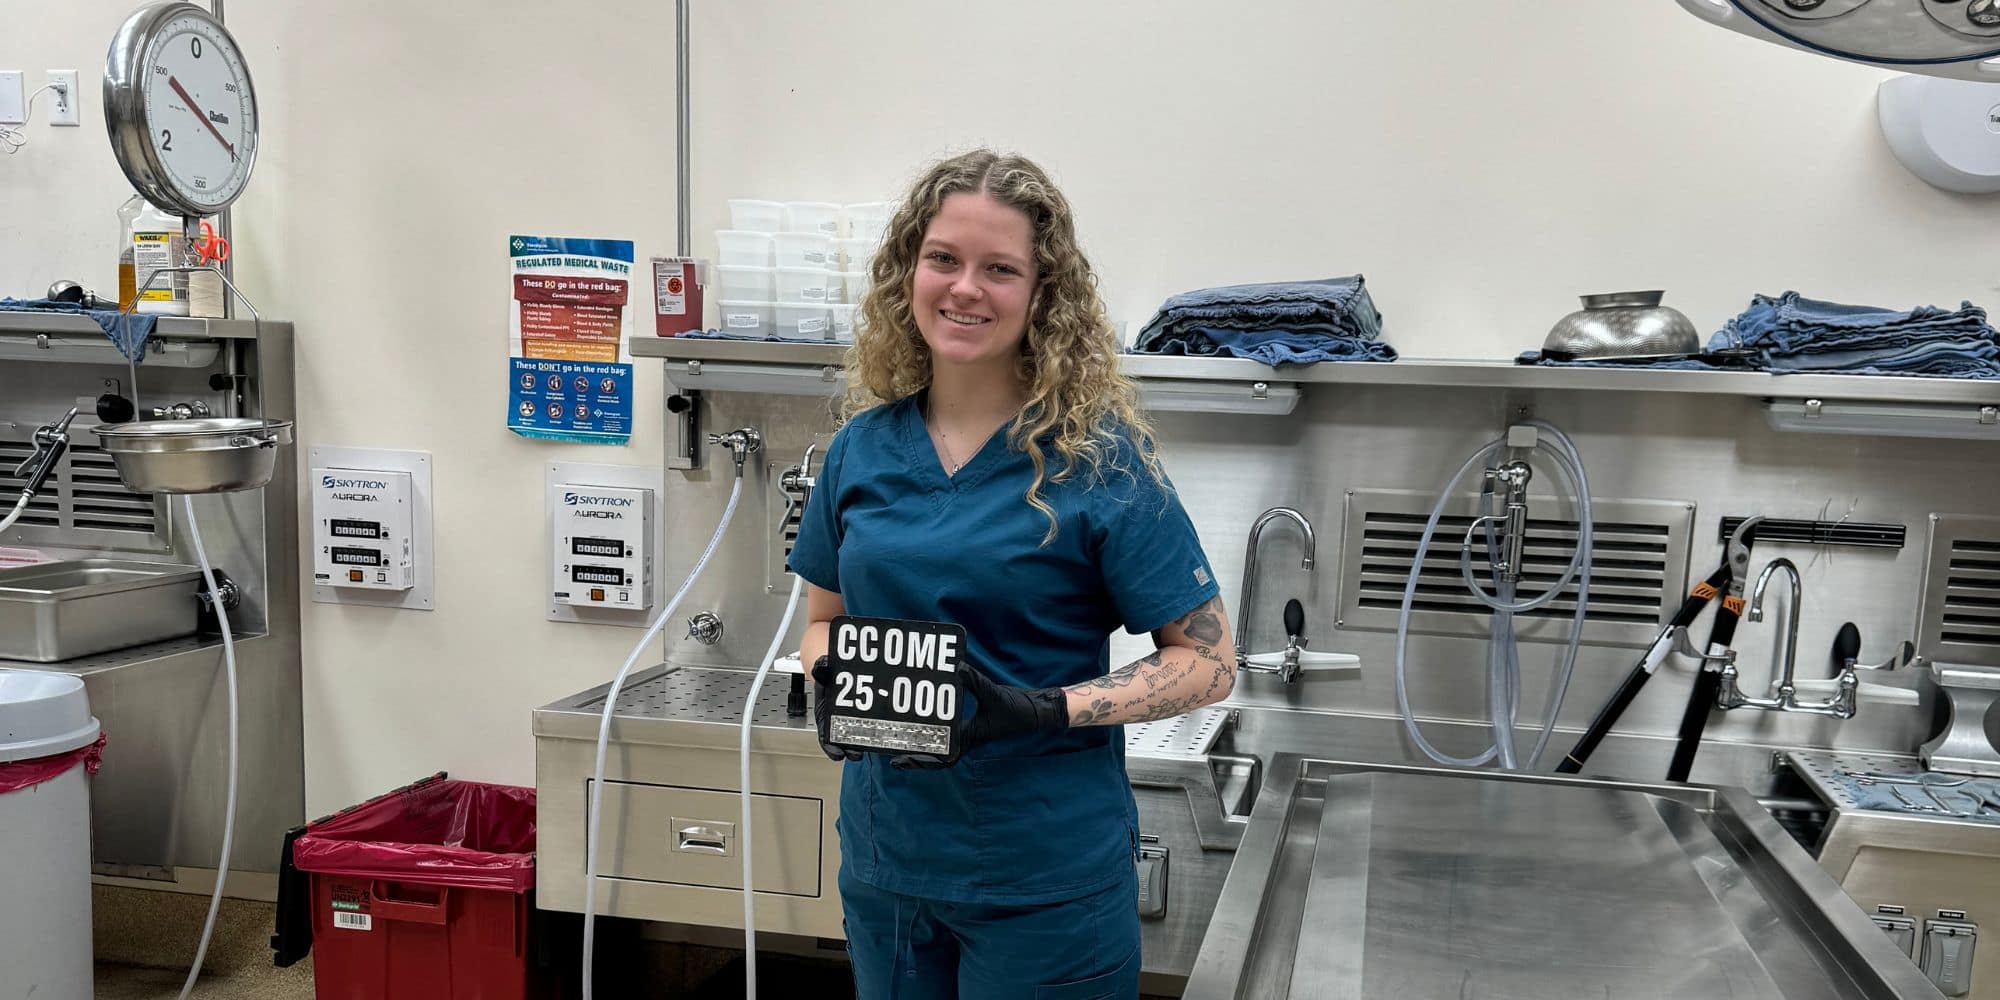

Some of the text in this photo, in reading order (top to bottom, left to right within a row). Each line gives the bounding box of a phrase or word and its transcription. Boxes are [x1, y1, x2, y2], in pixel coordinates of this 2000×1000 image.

[191, 37, 201, 58] 0
[156, 66, 167, 75] 500
[225, 83, 236, 93] 500
[162, 129, 172, 151] 2
[194, 179, 207, 188] 500
[516, 257, 629, 274] REGULATED MEDICAL WASTE
[523, 279, 622, 294] These DO go in the red bag:
[516, 361, 627, 376] These DON'T go in the red bag:
[336, 479, 386, 489] SKYTRON
[332, 493, 378, 502] AURORA
[579, 495, 631, 506] SKYTRON
[574, 509, 622, 519] AURORA
[323, 546, 329, 554] 2
[563, 564, 569, 573] 2
[835, 671, 956, 721] 25-000
